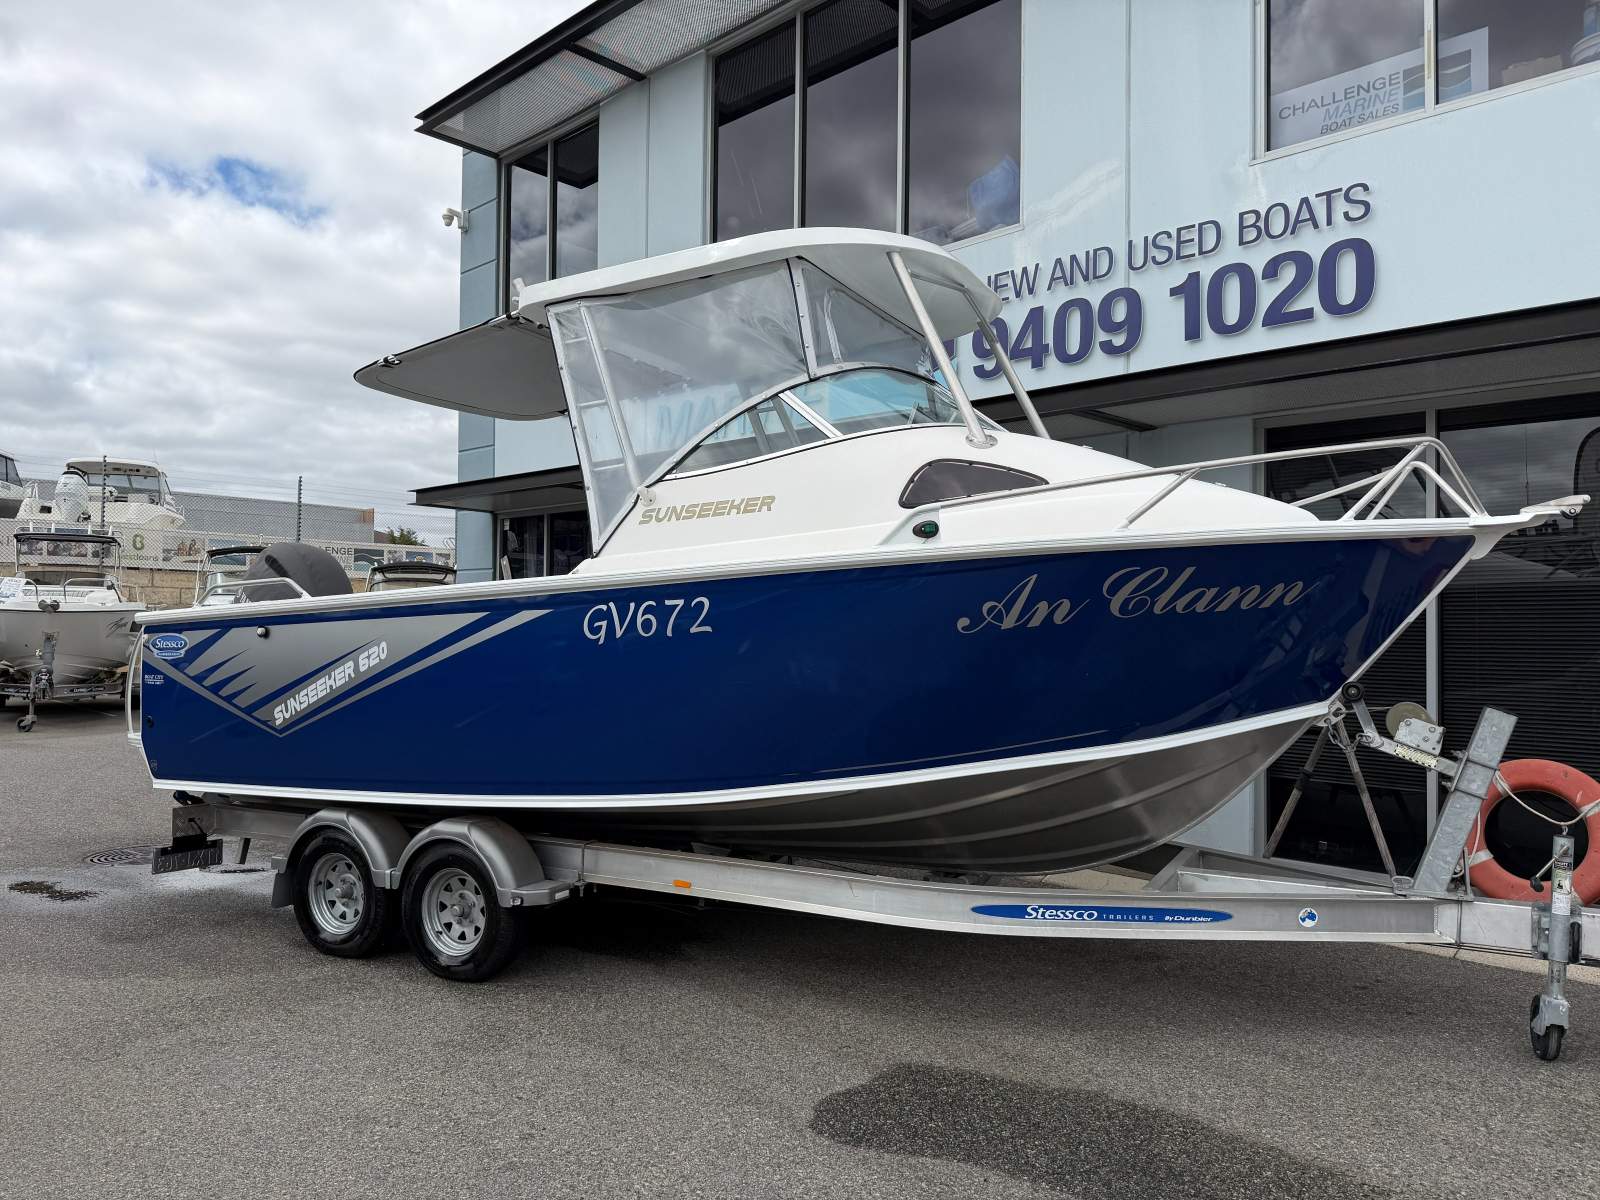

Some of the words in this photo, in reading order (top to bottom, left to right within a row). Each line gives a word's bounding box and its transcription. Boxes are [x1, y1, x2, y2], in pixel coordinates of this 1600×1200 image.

[1278, 71, 1401, 120] CHALLENGE
[1322, 88, 1400, 123] MARINE
[1320, 116, 1354, 135] BOAT
[1356, 103, 1400, 124] SALES
[987, 263, 1040, 302] EW
[1046, 245, 1114, 292] AND
[1127, 219, 1222, 272] USED
[1238, 182, 1371, 247] BOATS
[971, 286, 1144, 380] 9409
[1168, 237, 1376, 342] 1020
[638, 495, 776, 525] SUNSEEKER
[322, 546, 353, 556] ENGE
[583, 596, 713, 645] GV672
[956, 573, 1090, 634] An
[1102, 566, 1322, 618] Clann
[155, 638, 185, 649] Stessco
[273, 660, 355, 726] SUNSEEKER
[358, 641, 388, 673] 620
[1025, 905, 1097, 921] Stessco
